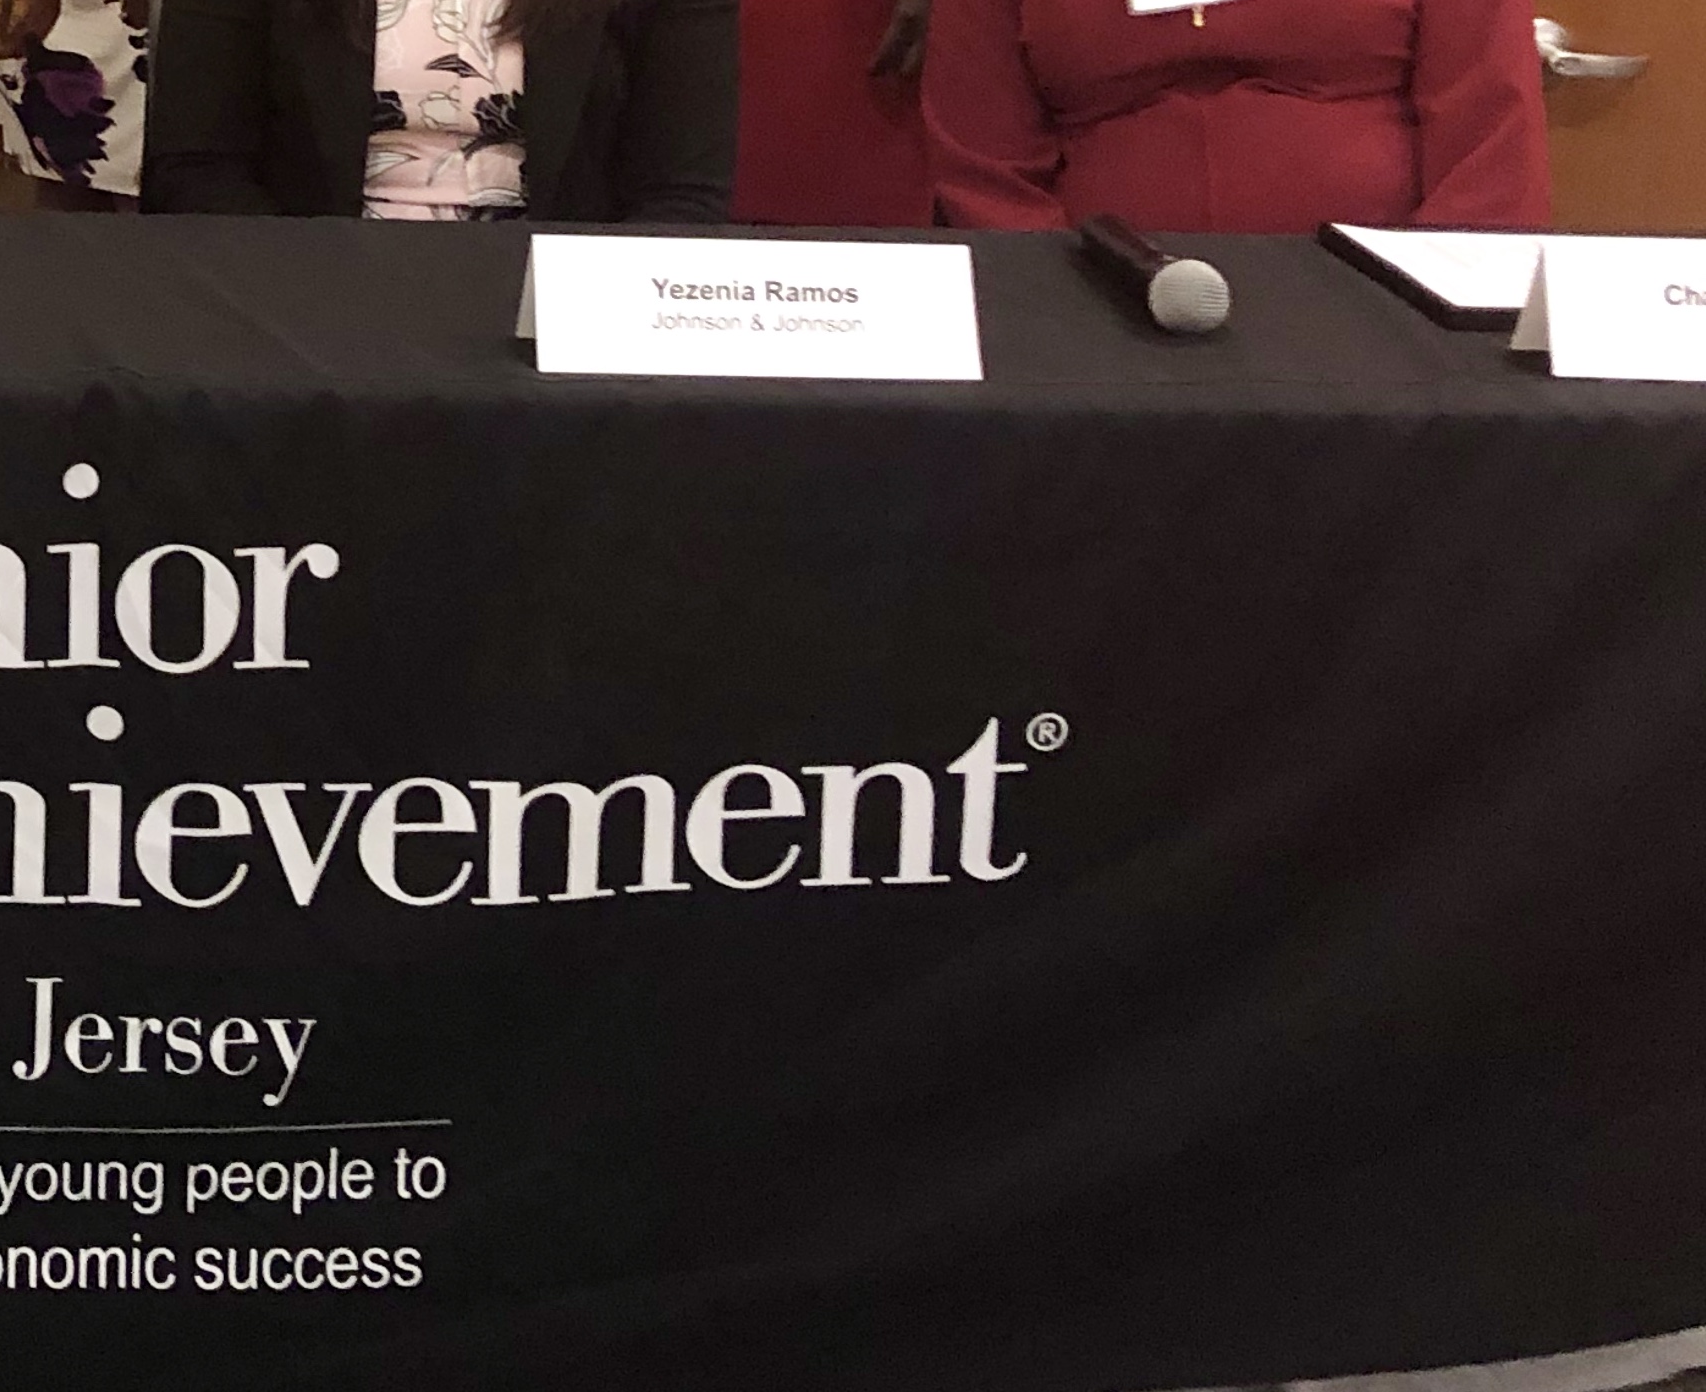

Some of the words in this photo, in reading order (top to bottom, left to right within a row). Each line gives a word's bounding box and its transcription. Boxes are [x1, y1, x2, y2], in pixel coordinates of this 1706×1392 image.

[651, 278, 755, 301] Yezenia
[765, 280, 859, 303] Ramos
[651, 312, 741, 332] Johnson
[750, 312, 765, 332] &
[773, 313, 865, 334] Johnson
[13, 978, 317, 1106] Jersey
[187, 1148, 374, 1214] people
[394, 1148, 446, 1199] to
[194, 1247, 422, 1290] success
